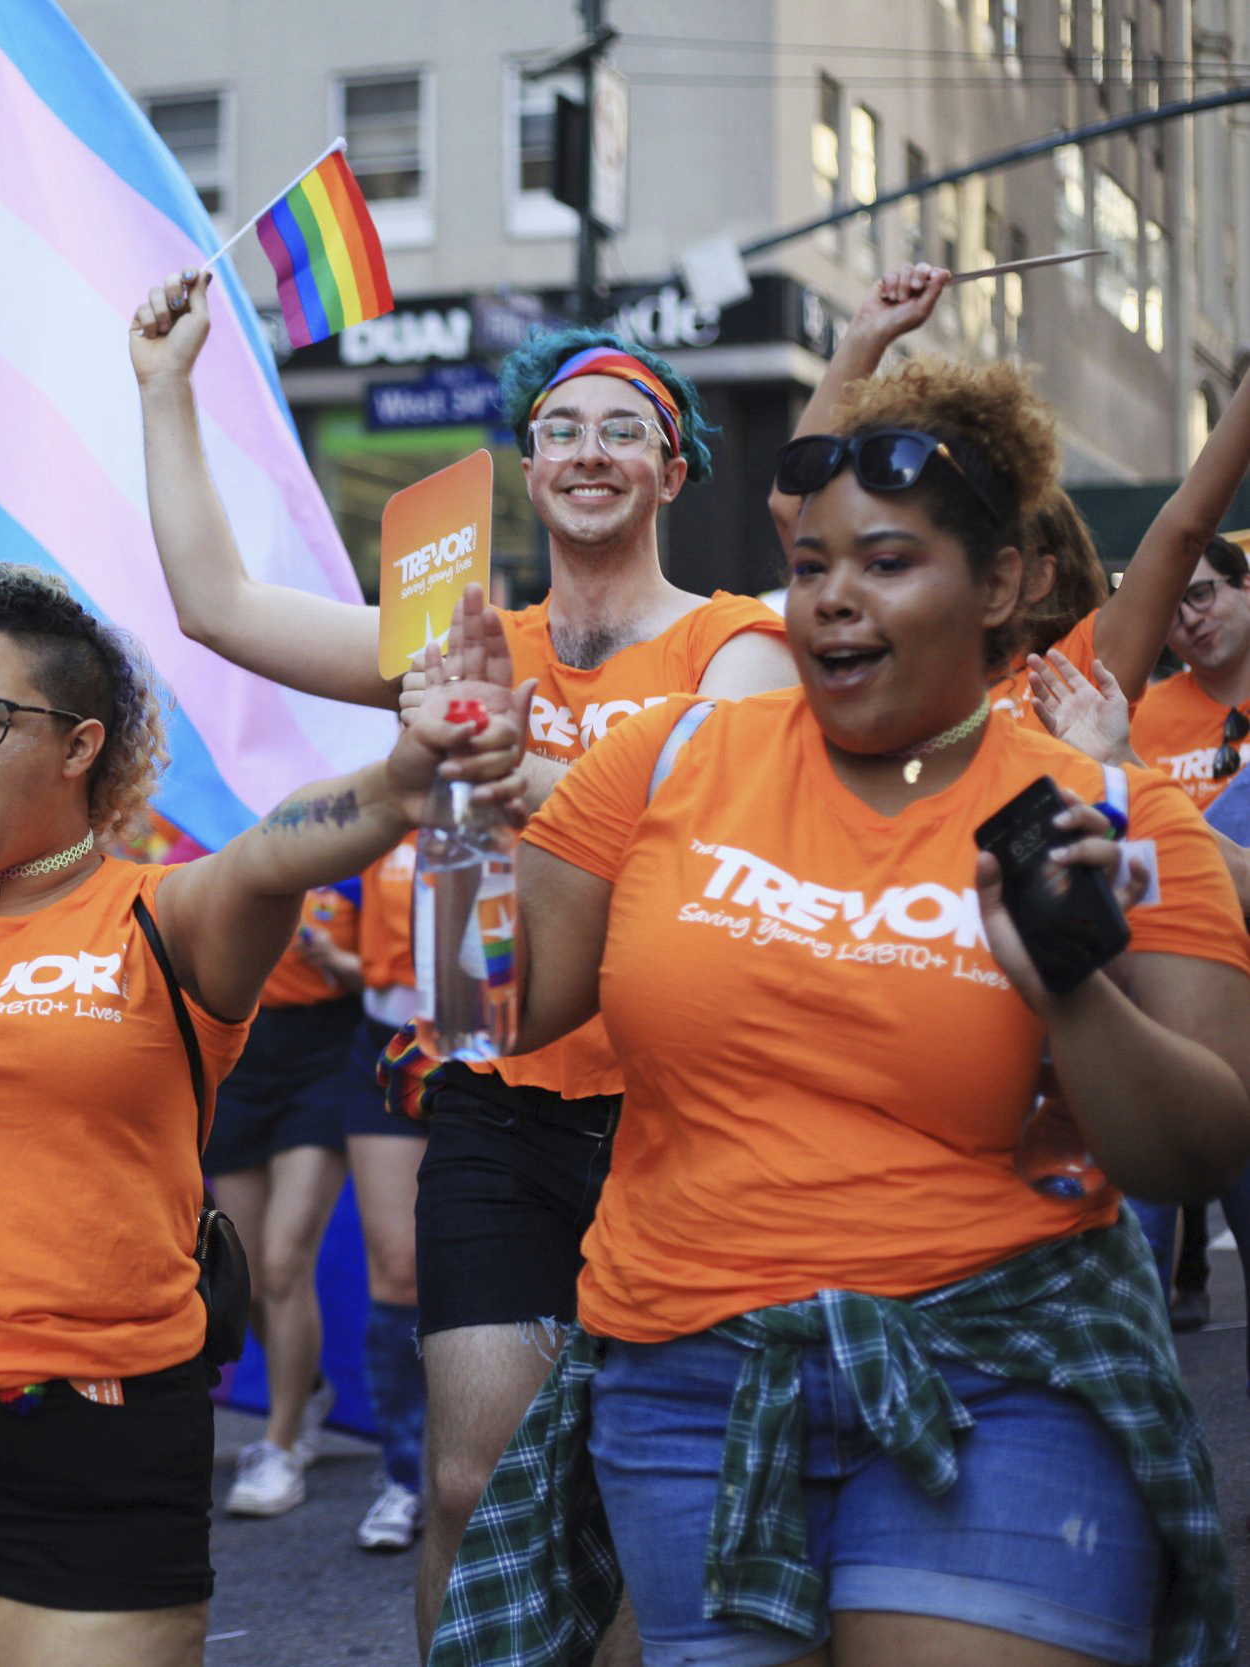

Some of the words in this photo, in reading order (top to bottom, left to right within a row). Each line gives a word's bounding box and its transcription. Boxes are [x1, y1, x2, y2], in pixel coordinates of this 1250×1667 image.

[400, 526, 473, 585] TREVOR
[690, 838, 718, 855] THE
[678, 902, 750, 938] Saving
[752, 917, 833, 958] Young
[835, 943, 948, 971] LGBTQ+
[953, 955, 1011, 991] Lives
[74, 999, 122, 1023] Lives
